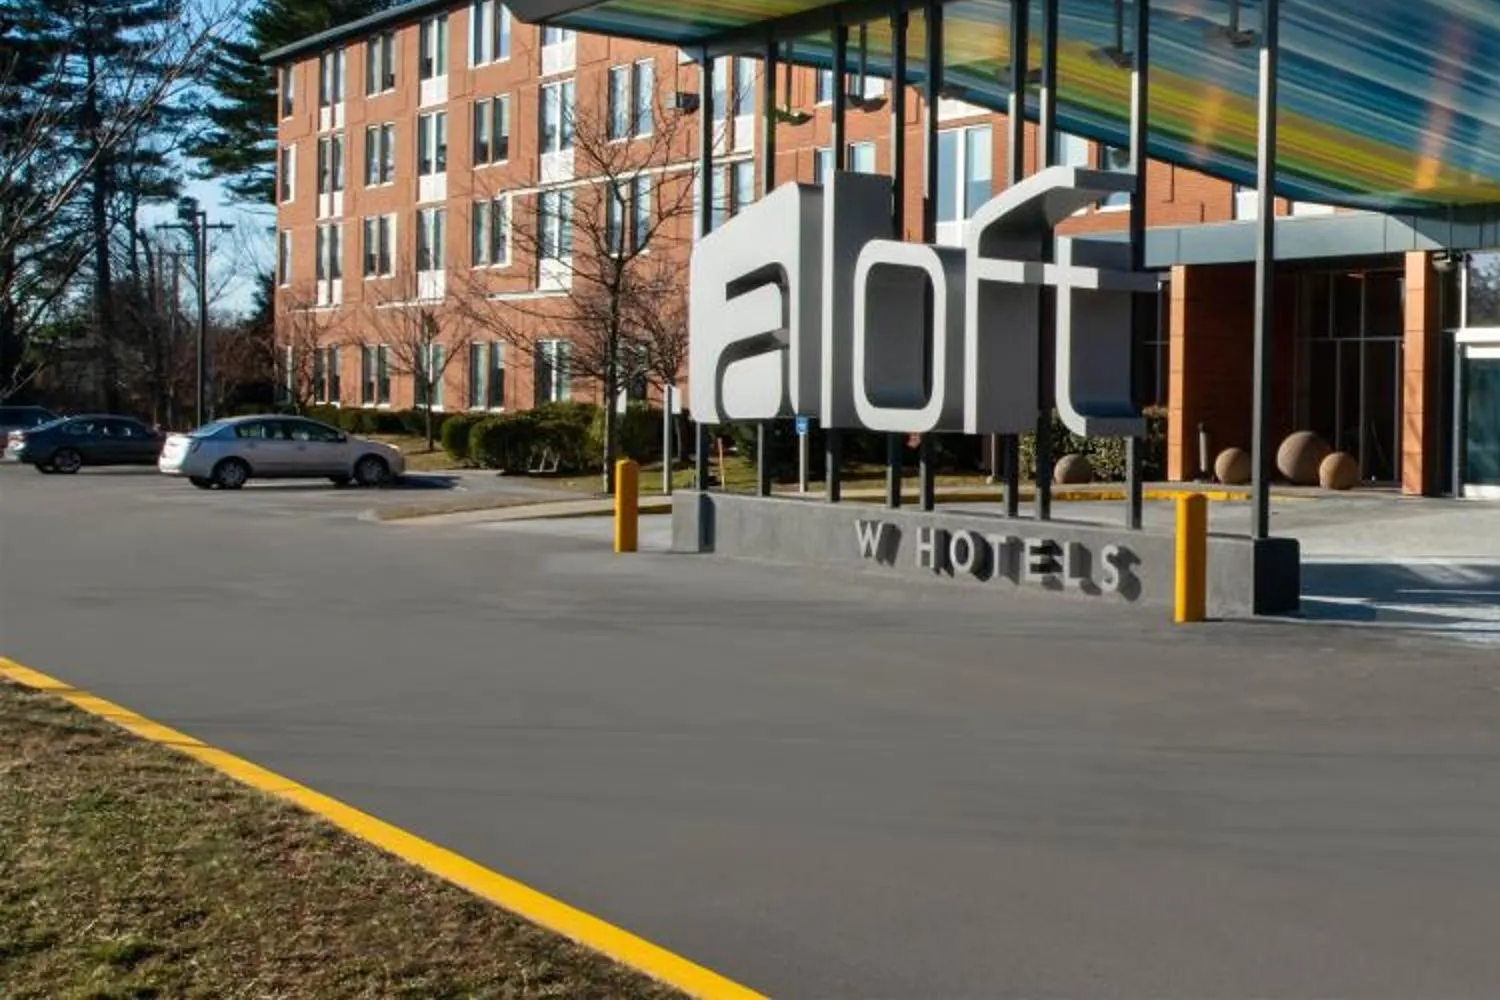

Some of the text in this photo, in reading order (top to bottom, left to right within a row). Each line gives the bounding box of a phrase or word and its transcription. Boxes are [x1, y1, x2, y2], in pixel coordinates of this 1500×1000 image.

[690, 165, 1100, 438] aloft
[855, 519, 1120, 593] W HOTELS
